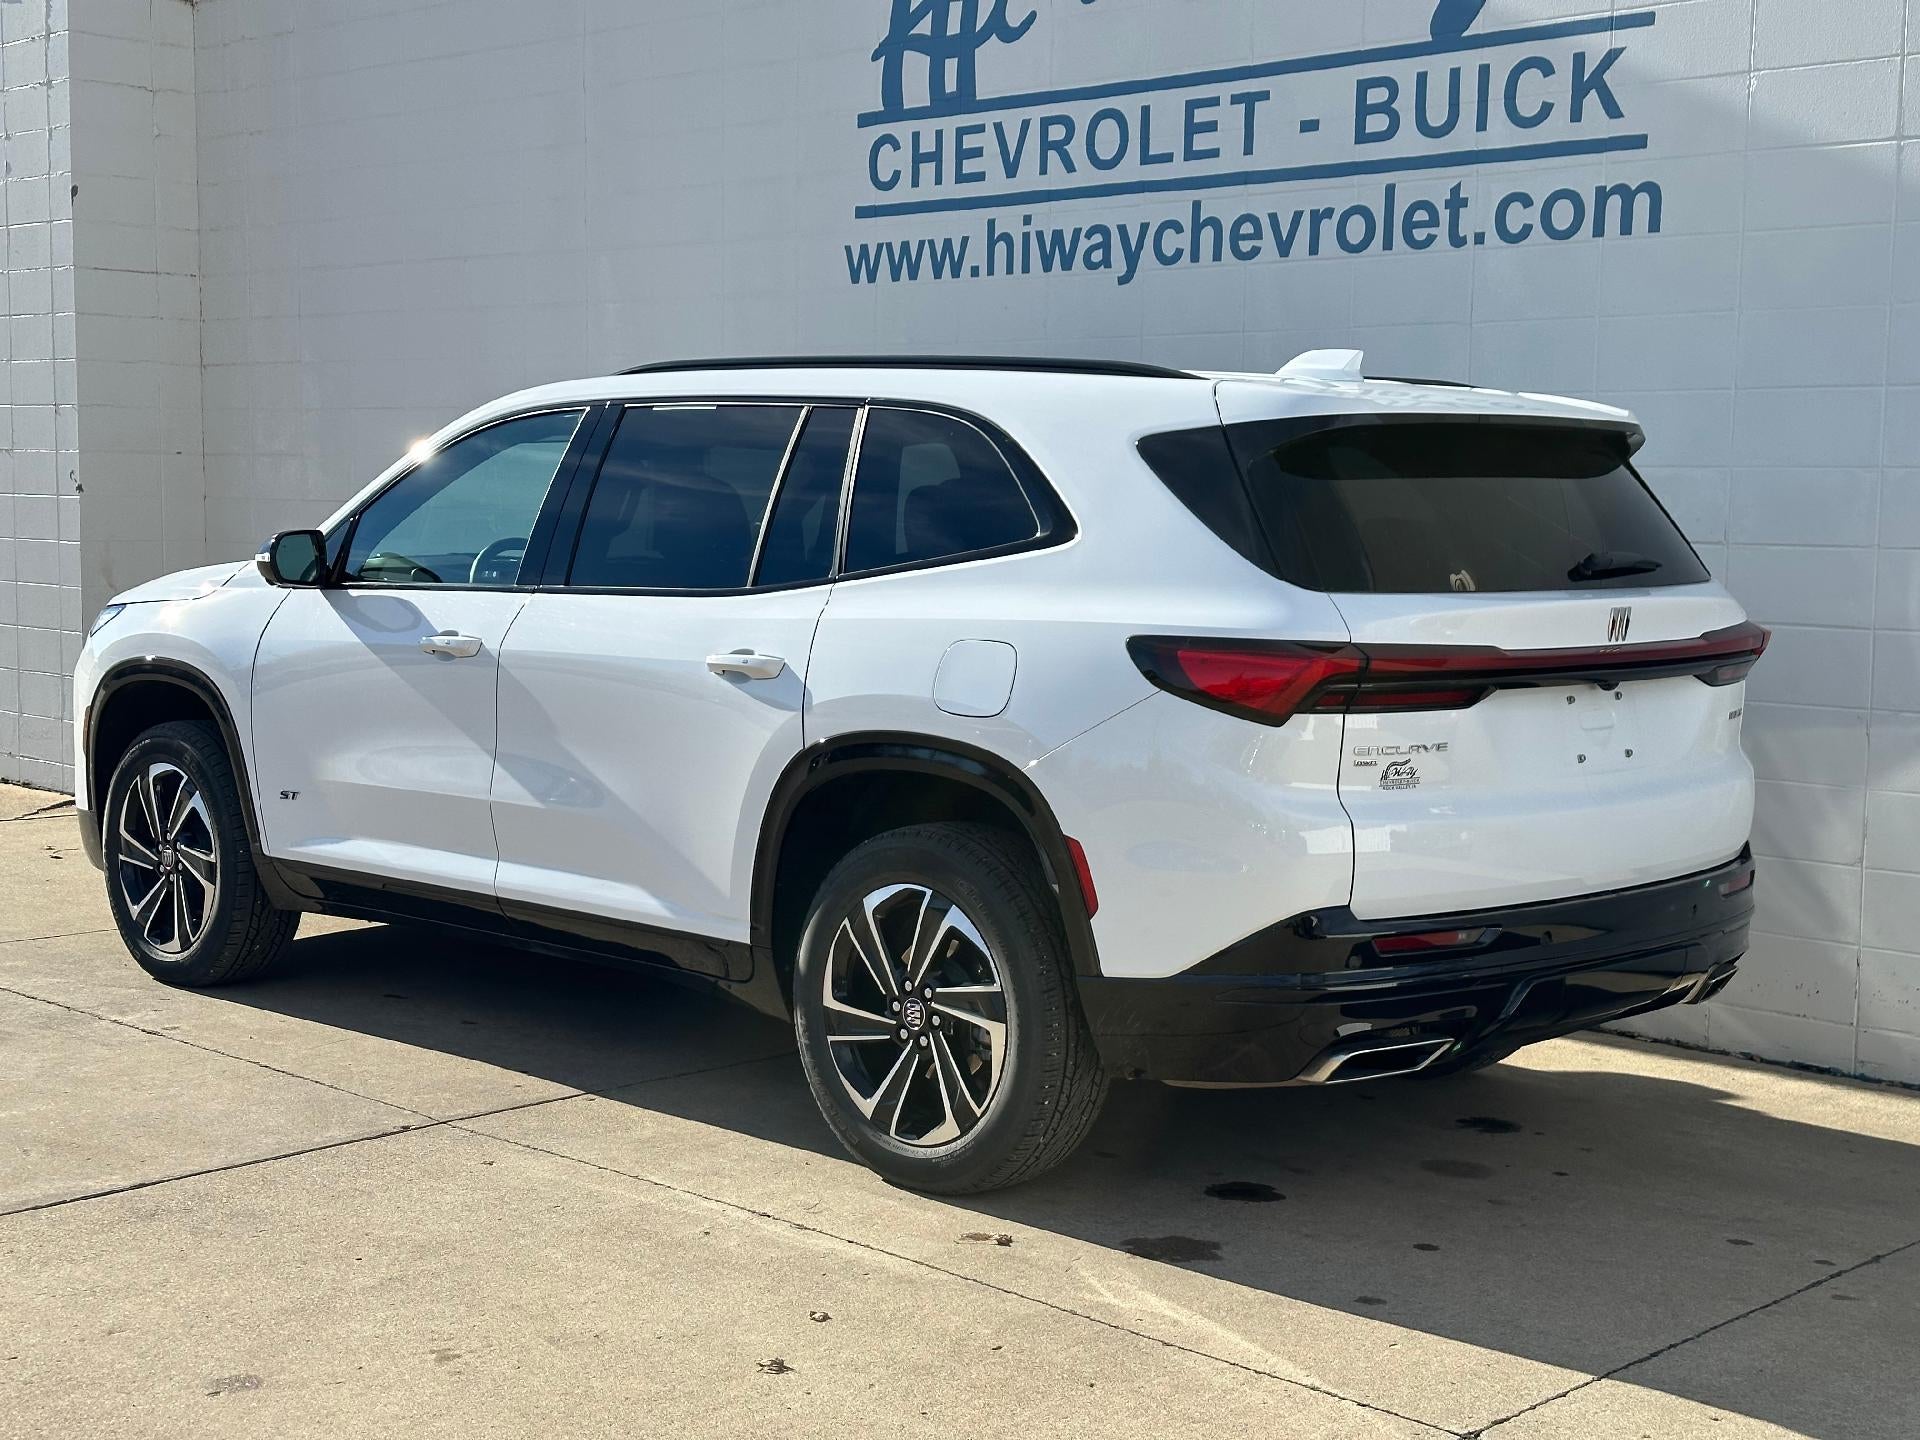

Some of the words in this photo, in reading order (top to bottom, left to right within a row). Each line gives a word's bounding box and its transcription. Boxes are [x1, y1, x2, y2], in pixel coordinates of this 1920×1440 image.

[870, 91, 1270, 192] CHEVROLET
[1300, 119, 1319, 134] -
[1355, 48, 1622, 144] BUICK
[845, 181, 1662, 285] www.hiwaychevrolet.com
[1354, 743, 1447, 755] ENCLAVE
[279, 790, 300, 801] ST
